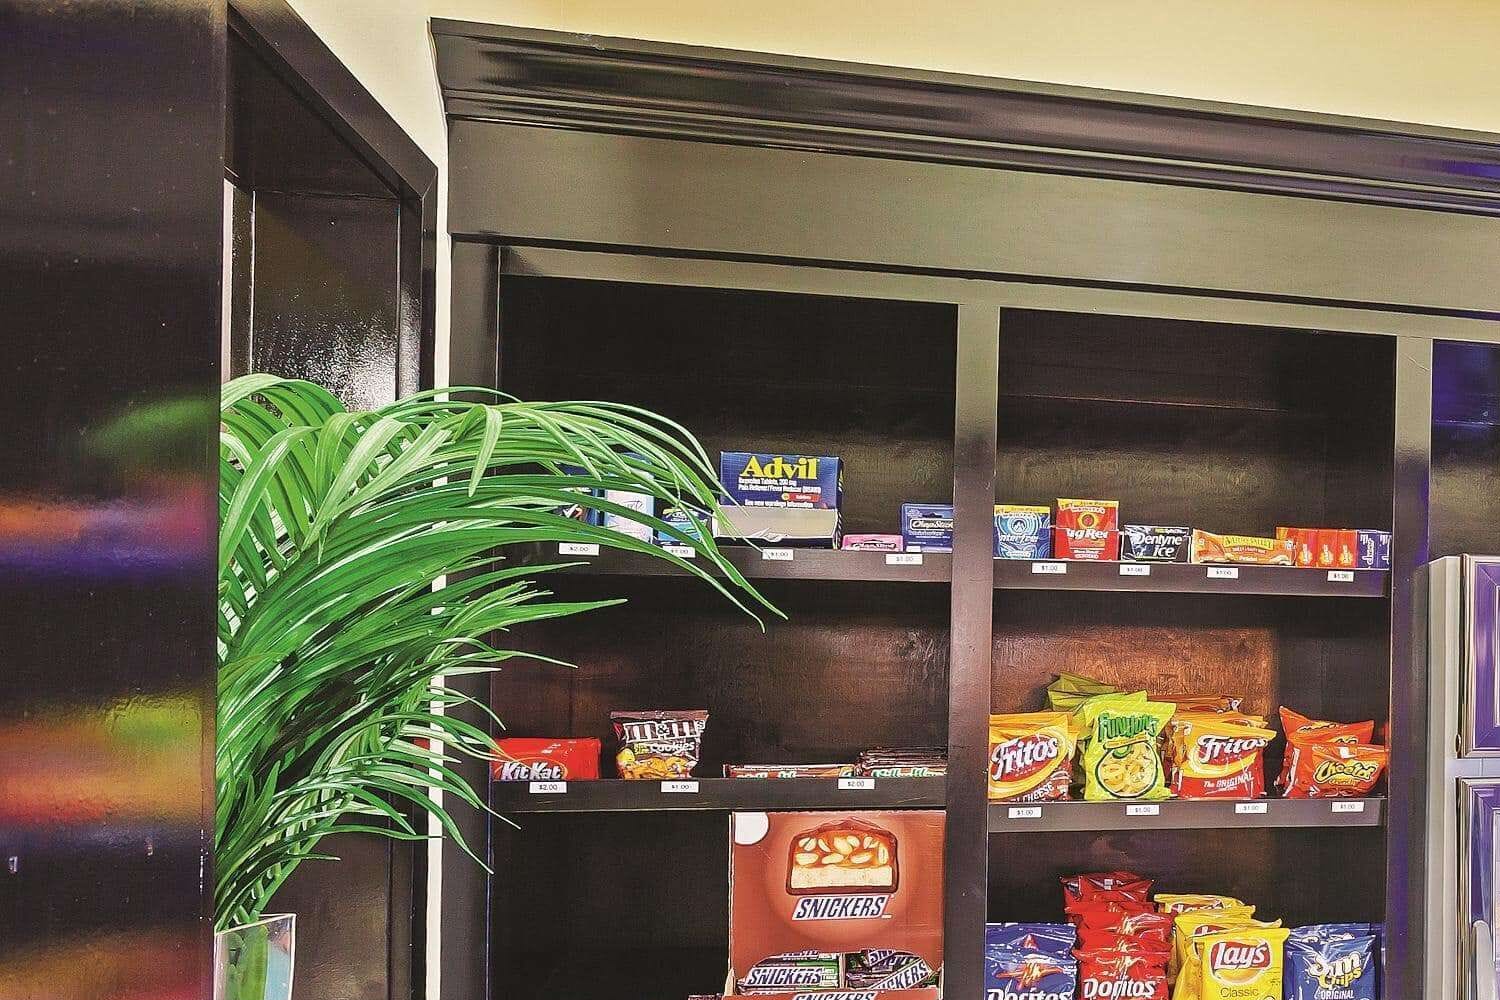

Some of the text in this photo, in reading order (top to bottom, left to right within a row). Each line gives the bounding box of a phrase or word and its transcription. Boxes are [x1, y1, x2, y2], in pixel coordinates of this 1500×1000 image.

[740, 456, 818, 480] Advil
[1134, 533, 1182, 546] Dentyne
[650, 742, 695, 753] Cookies
[991, 734, 1059, 781] Fritos
[1198, 735, 1269, 763] Fritos
[501, 762, 562, 780] Kit Kat
[1216, 772, 1254, 789] ORIGINAL
[1313, 760, 1379, 783] Cheetos
[796, 896, 885, 918] SNICKERS
[1213, 940, 1267, 969] Lay's
[749, 968, 823, 985] SNICKERS
[878, 961, 929, 989] ICKERS
[1083, 978, 1157, 998] Doritos
[1220, 987, 1260, 998] Classic
[1320, 989, 1355, 1000] ORIGINAL
